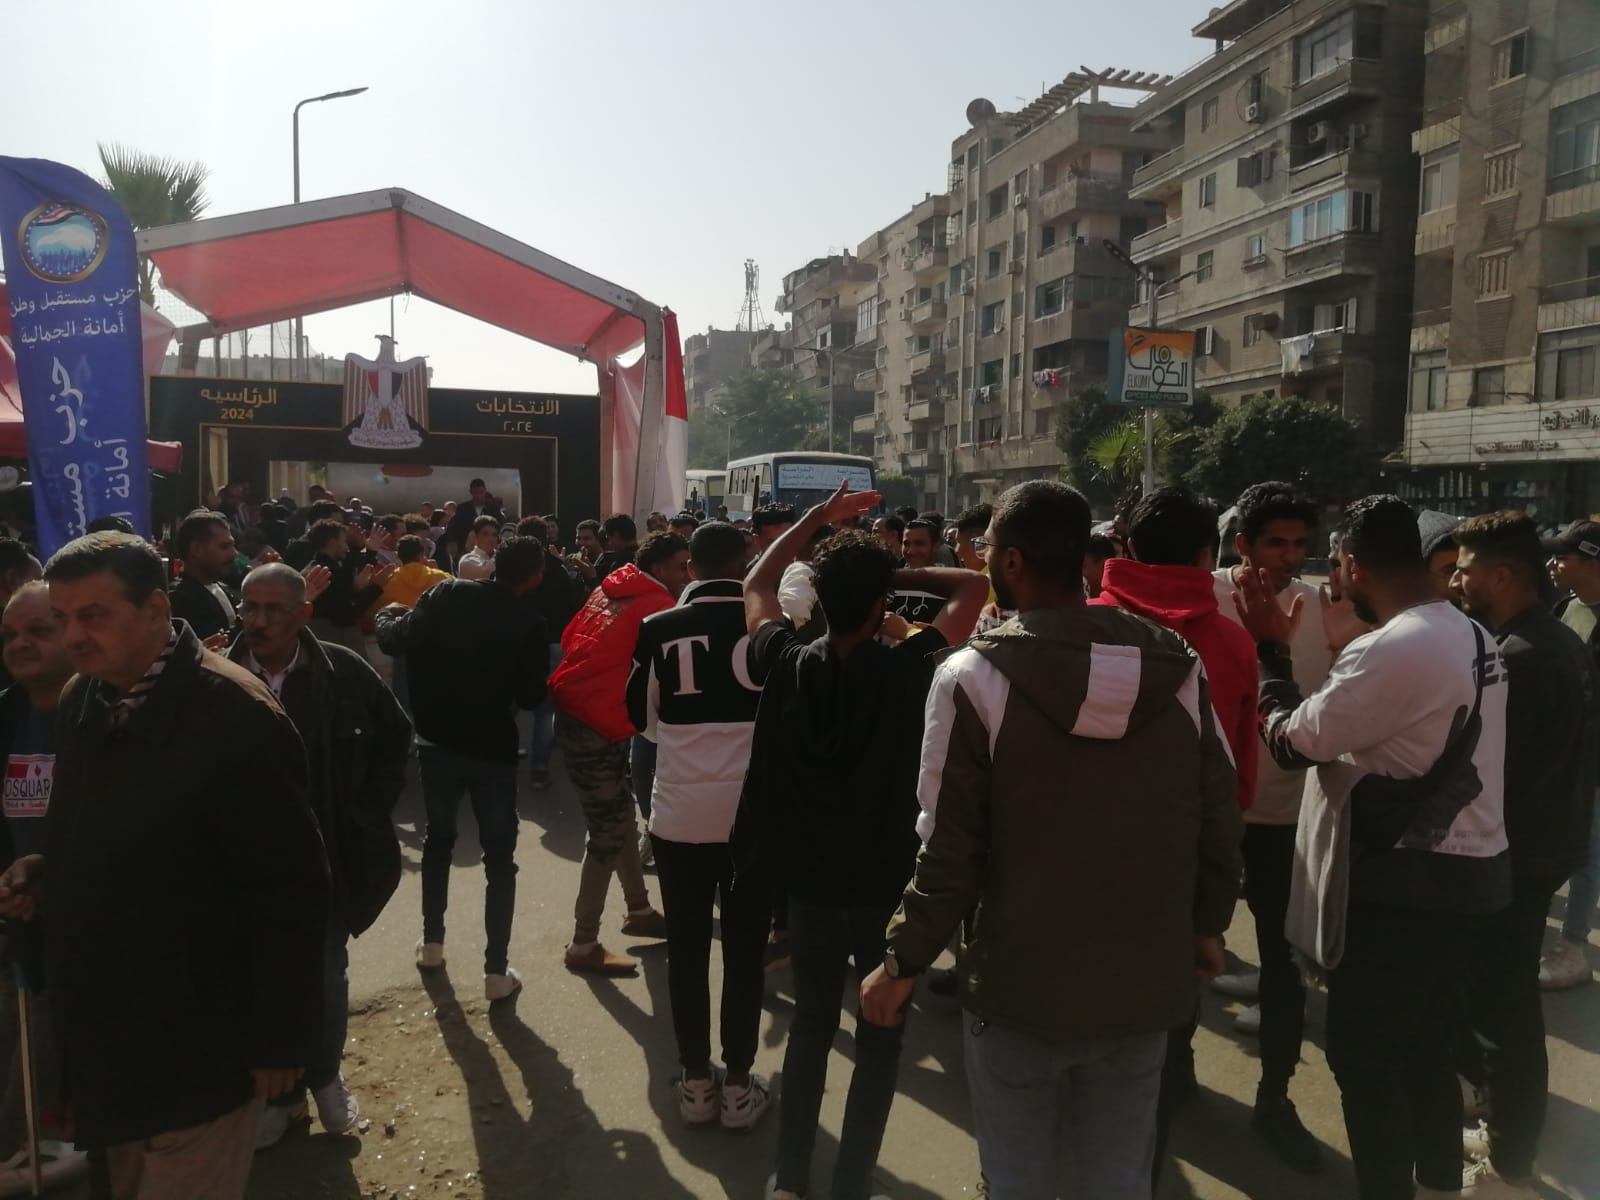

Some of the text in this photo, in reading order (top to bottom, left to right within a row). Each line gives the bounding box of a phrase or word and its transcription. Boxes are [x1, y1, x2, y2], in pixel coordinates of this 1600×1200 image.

[10, 287, 137, 318] حزب مستقبل وطن
[21, 310, 125, 349] أمانة الجمالية
[51, 356, 88, 444] حزب
[221, 407, 254, 420] 2024
[476, 397, 560, 416] الانتخابات
[94, 438, 131, 498] أمانة
